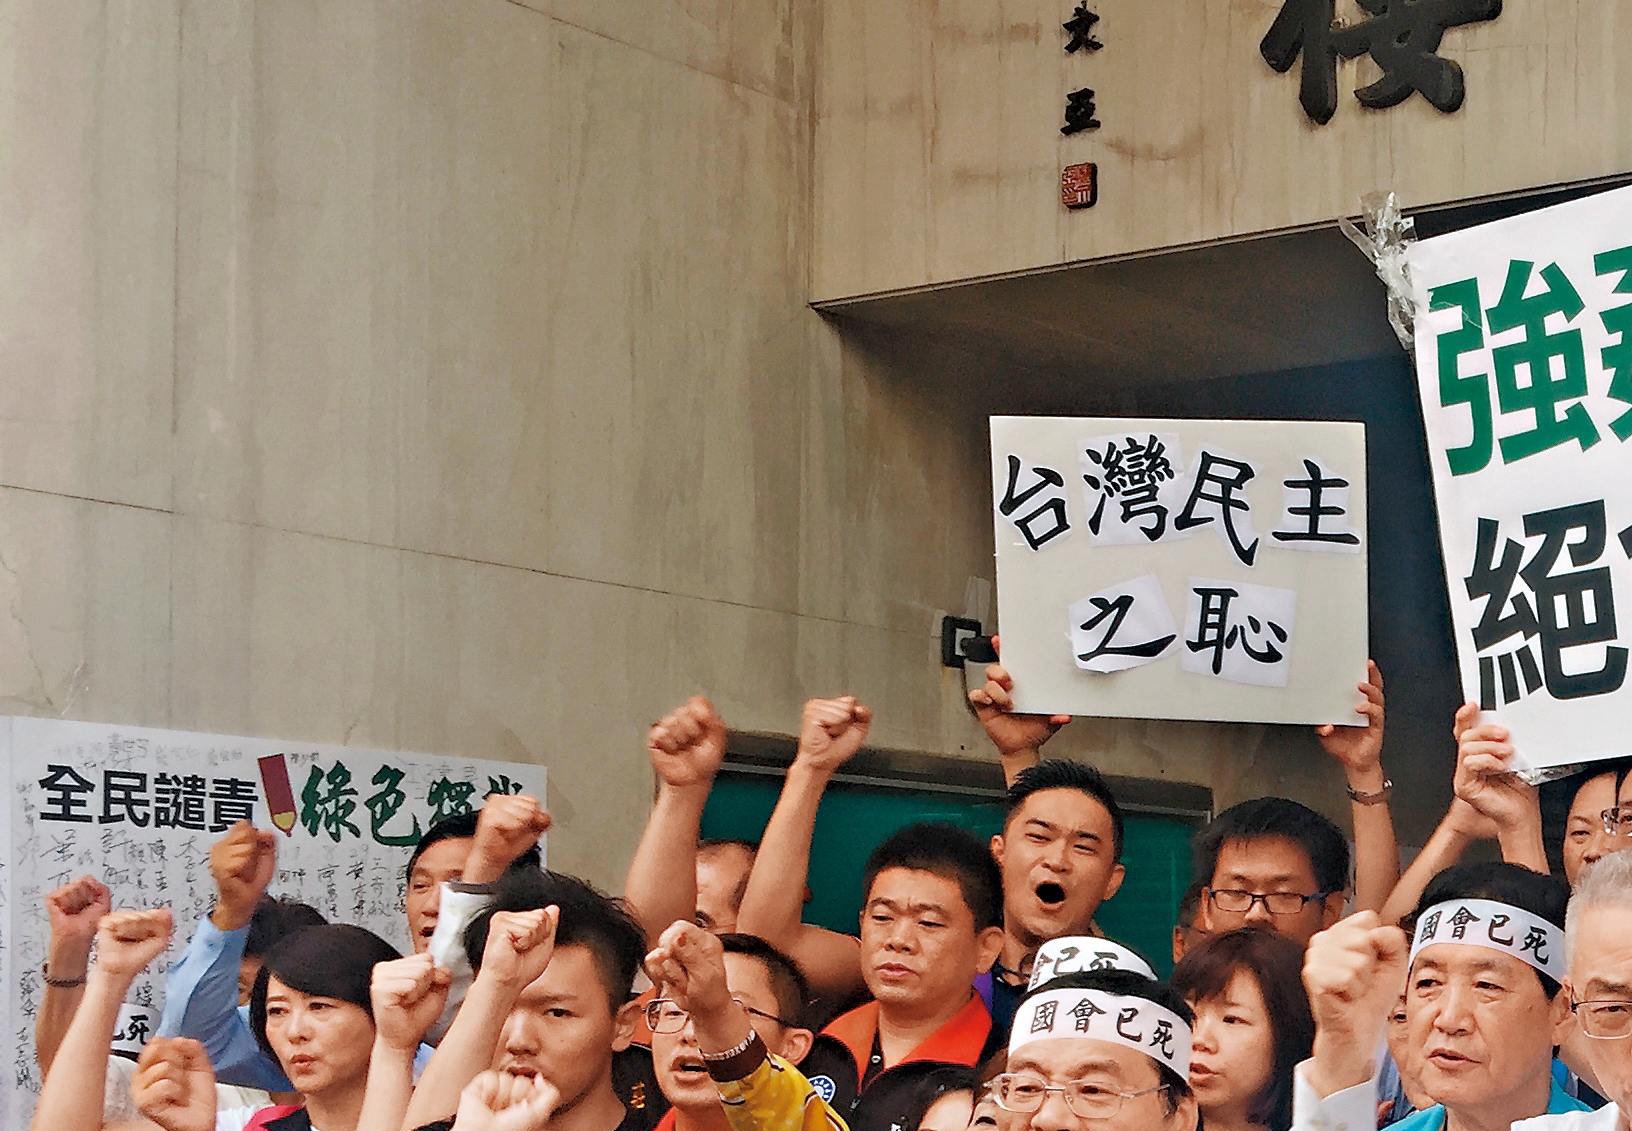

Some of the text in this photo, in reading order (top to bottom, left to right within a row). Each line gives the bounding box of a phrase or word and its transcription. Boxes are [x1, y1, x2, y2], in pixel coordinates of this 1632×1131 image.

[999, 434, 1361, 567] 台灣民主
[1077, 587, 1289, 675] 之恥
[38, 764, 259, 833] 全民譴責
[1420, 905, 1550, 966] 國會已死
[112, 1014, 150, 1046] 死
[1030, 998, 1175, 1060] 國會已死
